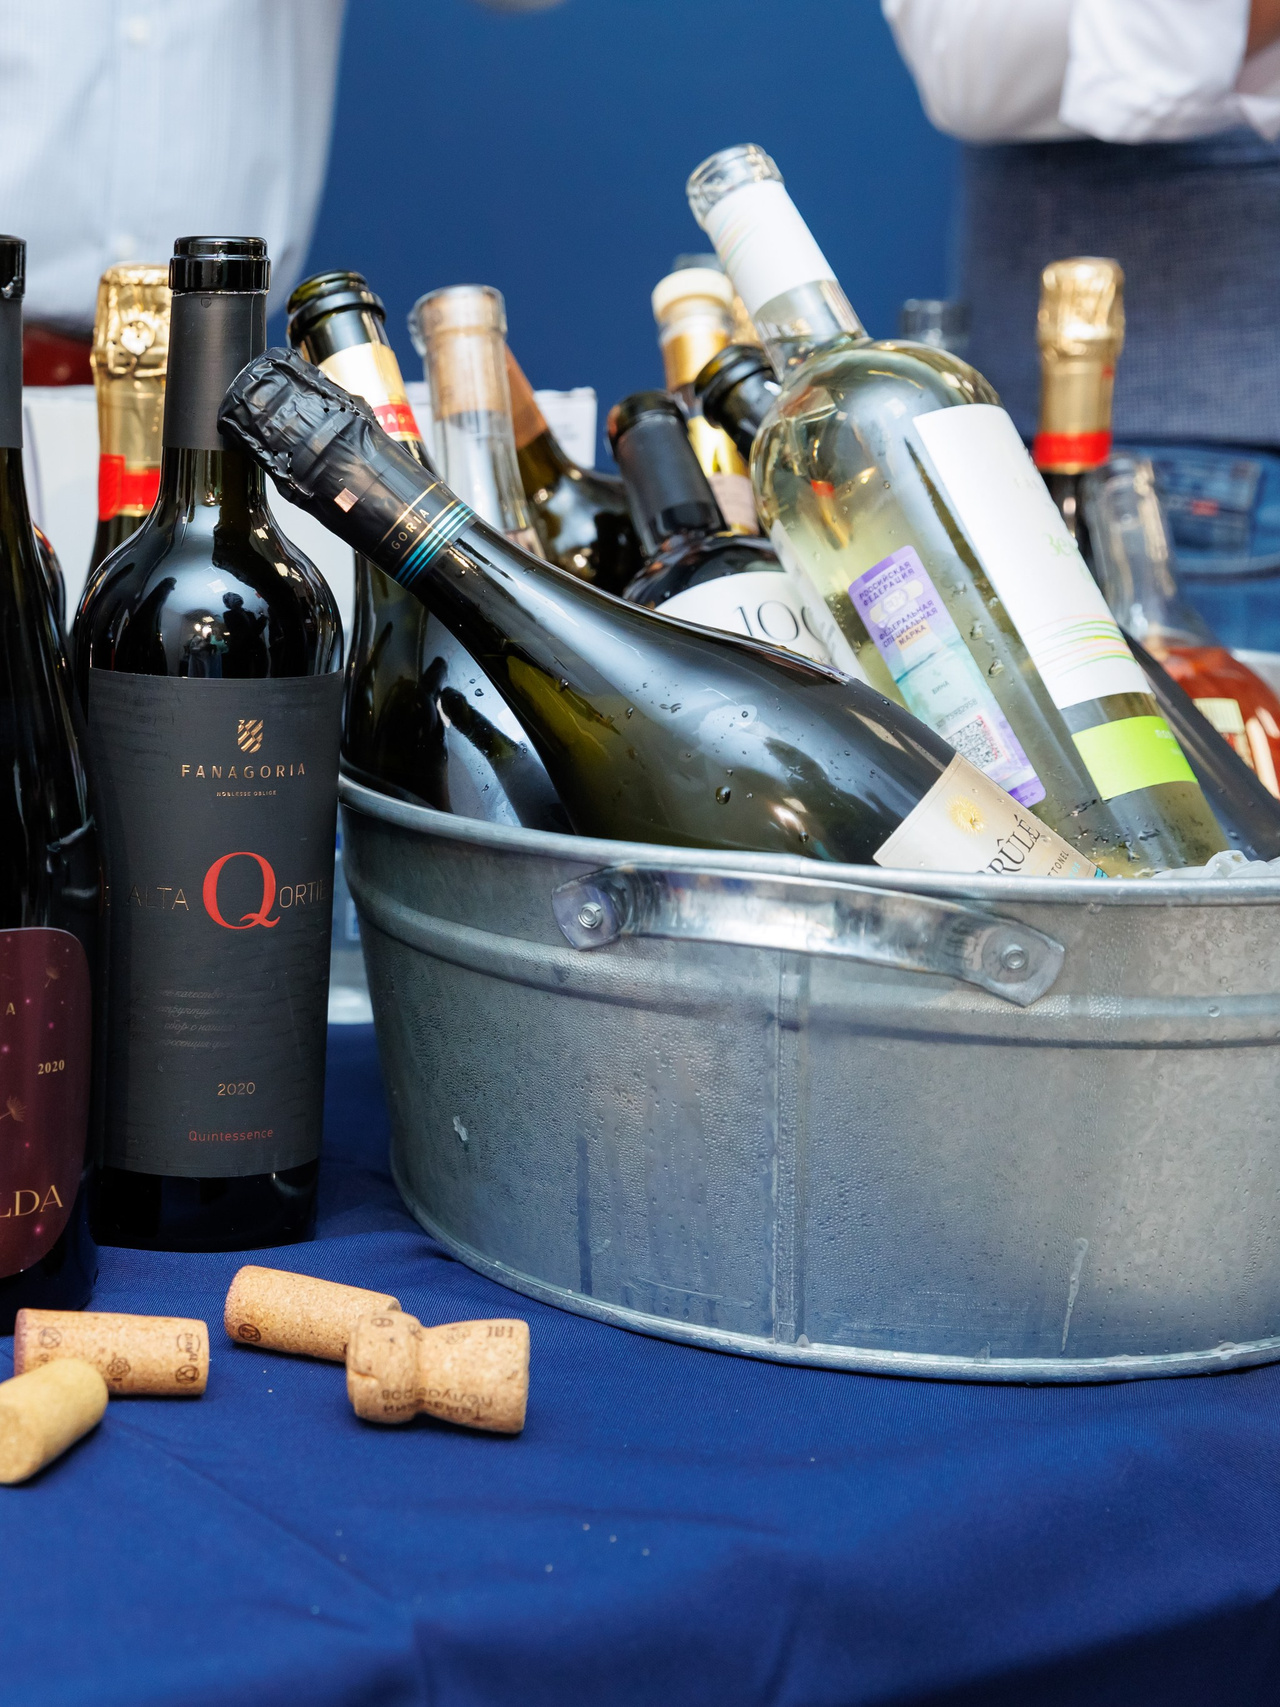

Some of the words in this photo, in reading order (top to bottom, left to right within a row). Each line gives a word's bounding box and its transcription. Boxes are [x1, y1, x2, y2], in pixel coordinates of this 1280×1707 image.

[858, 561, 912, 601] РОССИЙСКАЯ
[863, 567, 915, 607] ФЕДЕРАЦИЯ
[879, 599, 935, 640] ФЕДЕРАЛЬНАЯ
[883, 606, 938, 648] СПЕЦИАЛЬНАЯ
[898, 624, 927, 646] МАРКА
[181, 763, 306, 779] FANAGORIA
[253, 789, 277, 797] OBLIGE
[976, 814, 1042, 874] RÛLÉ
[37, 1059, 66, 1075] 2020
[217, 1081, 256, 1096] 2020
[188, 1128, 274, 1142] Quintessence
